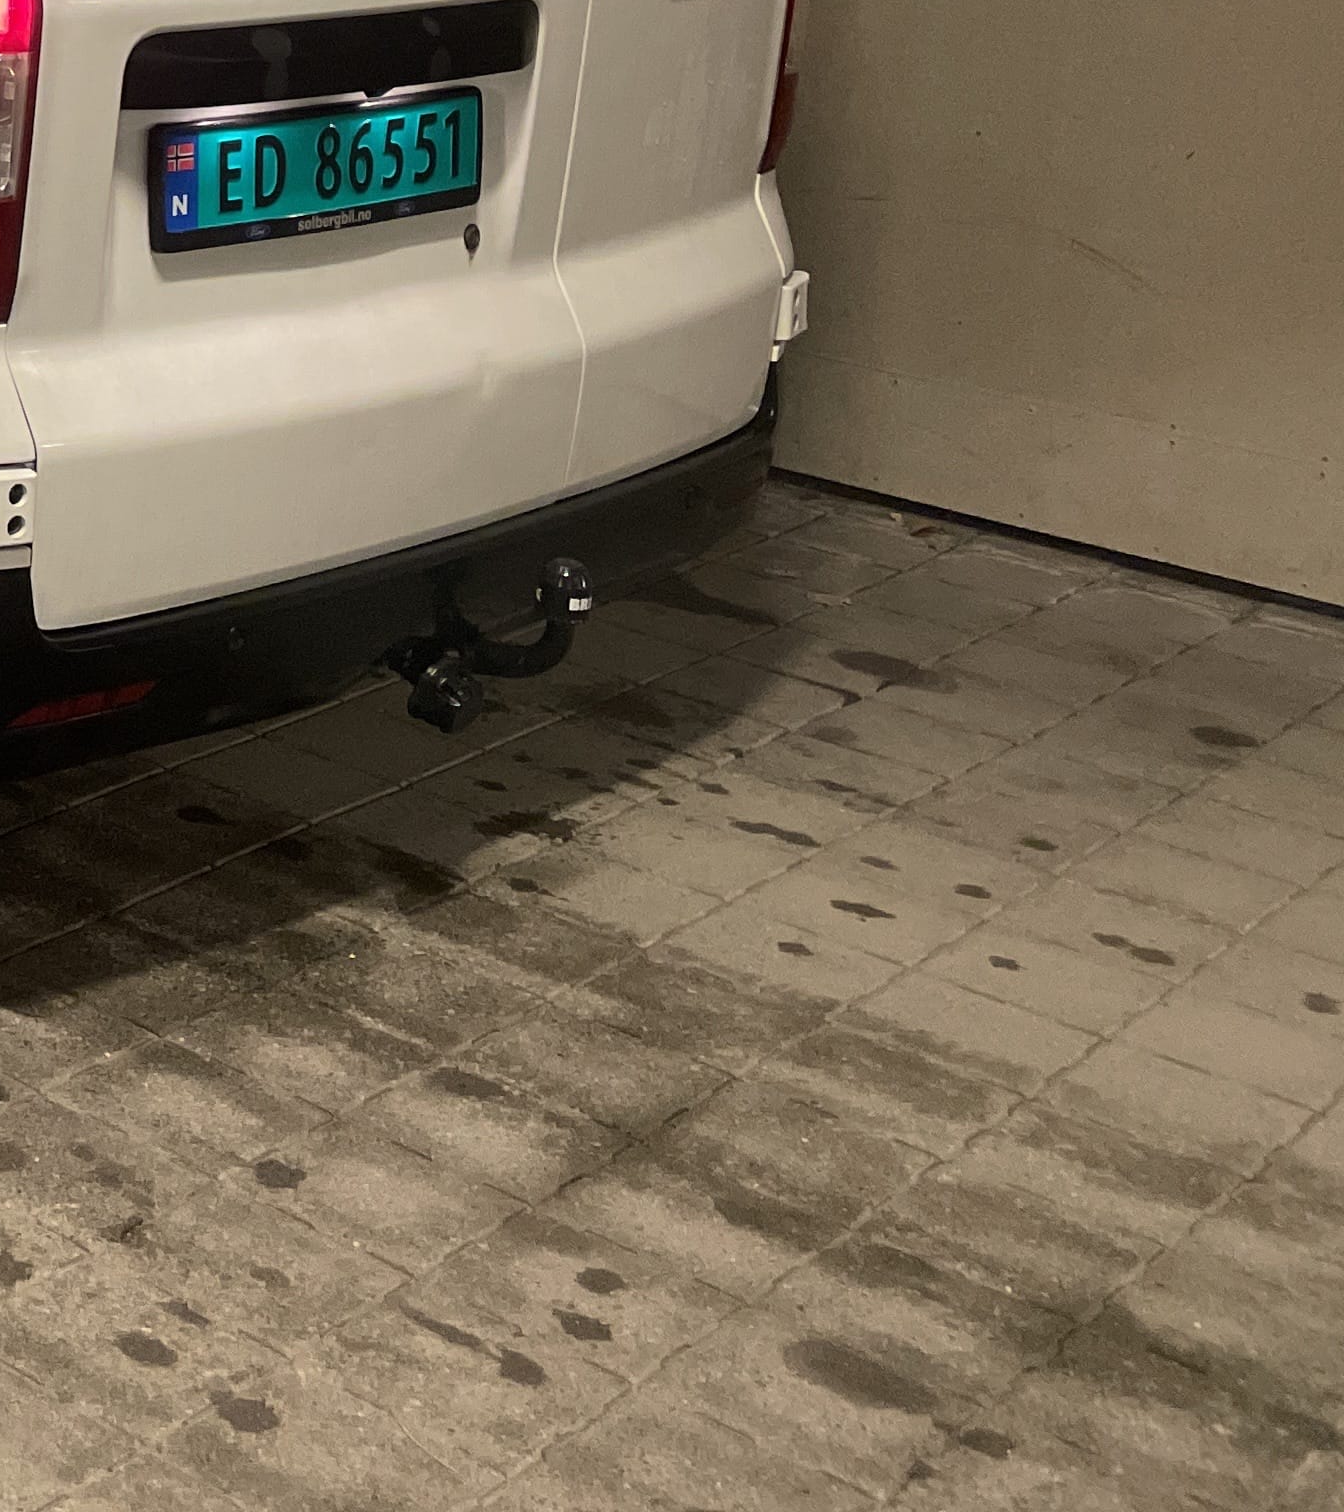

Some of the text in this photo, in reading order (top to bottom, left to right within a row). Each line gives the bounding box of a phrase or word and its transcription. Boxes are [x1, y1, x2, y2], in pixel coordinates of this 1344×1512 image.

[217, 108, 462, 215] ED 86551
[171, 193, 189, 218] N
[296, 208, 373, 233] solbergbil.no
